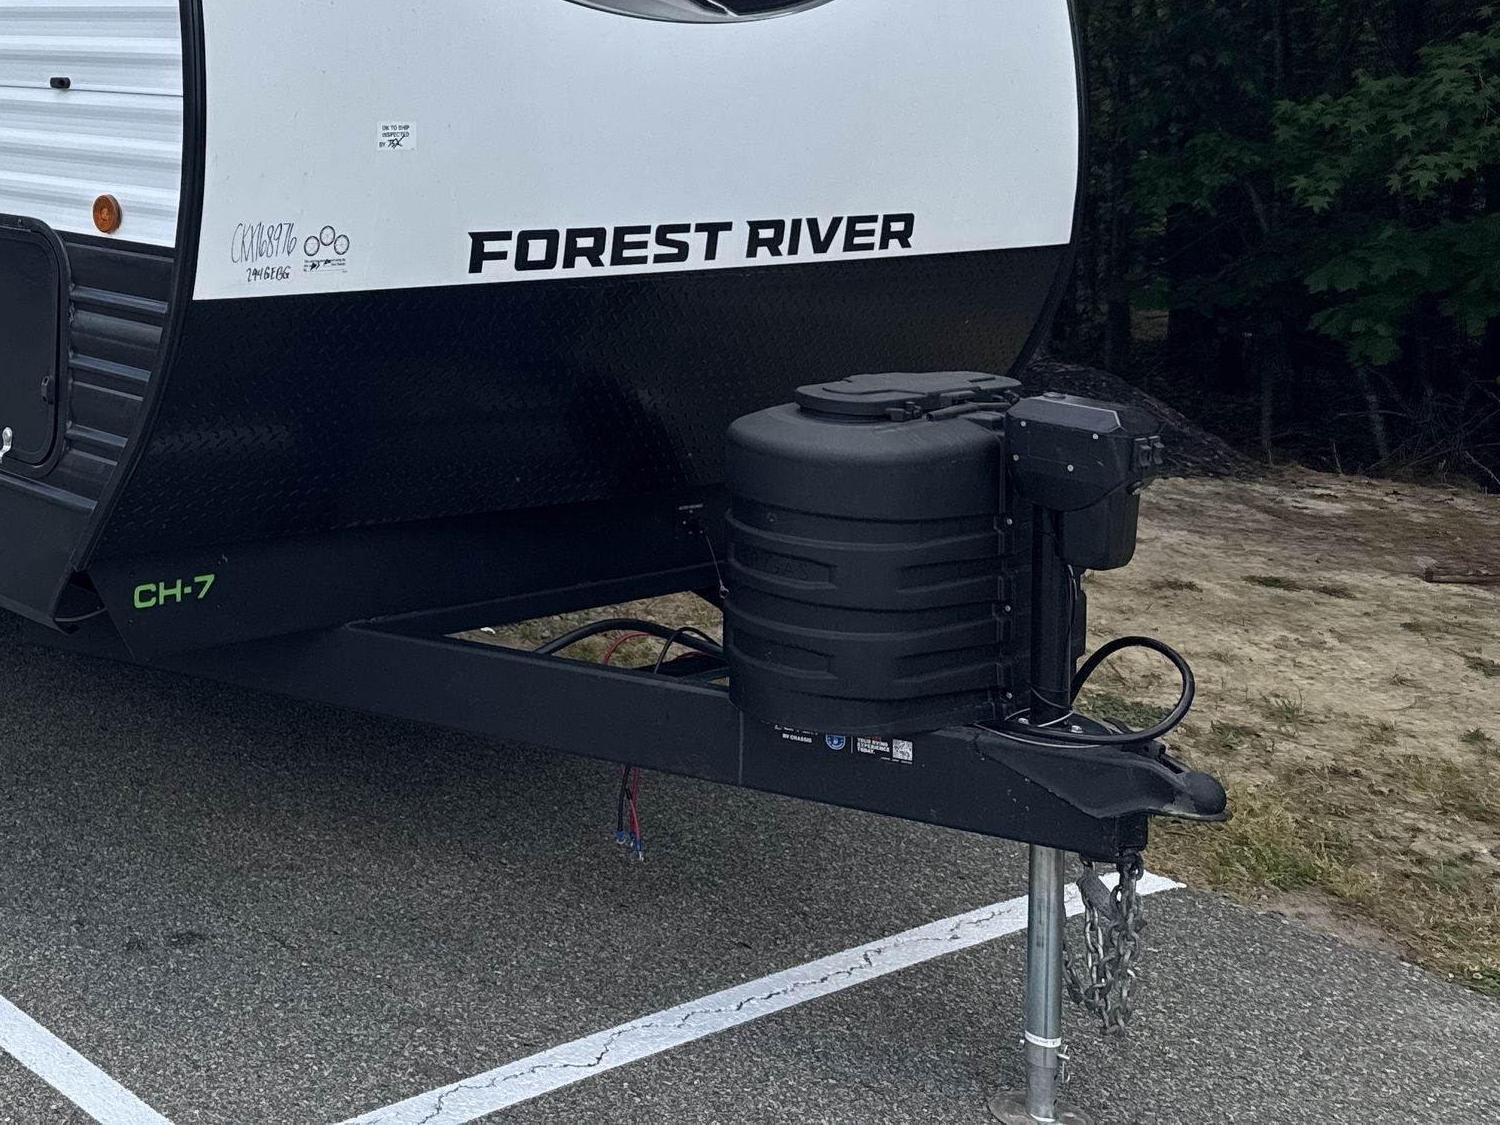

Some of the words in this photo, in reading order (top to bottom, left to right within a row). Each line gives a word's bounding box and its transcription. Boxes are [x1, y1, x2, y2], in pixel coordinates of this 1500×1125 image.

[467, 220, 734, 275] FOREST
[745, 212, 916, 259] RIVER
[133, 573, 215, 609] CH-7
